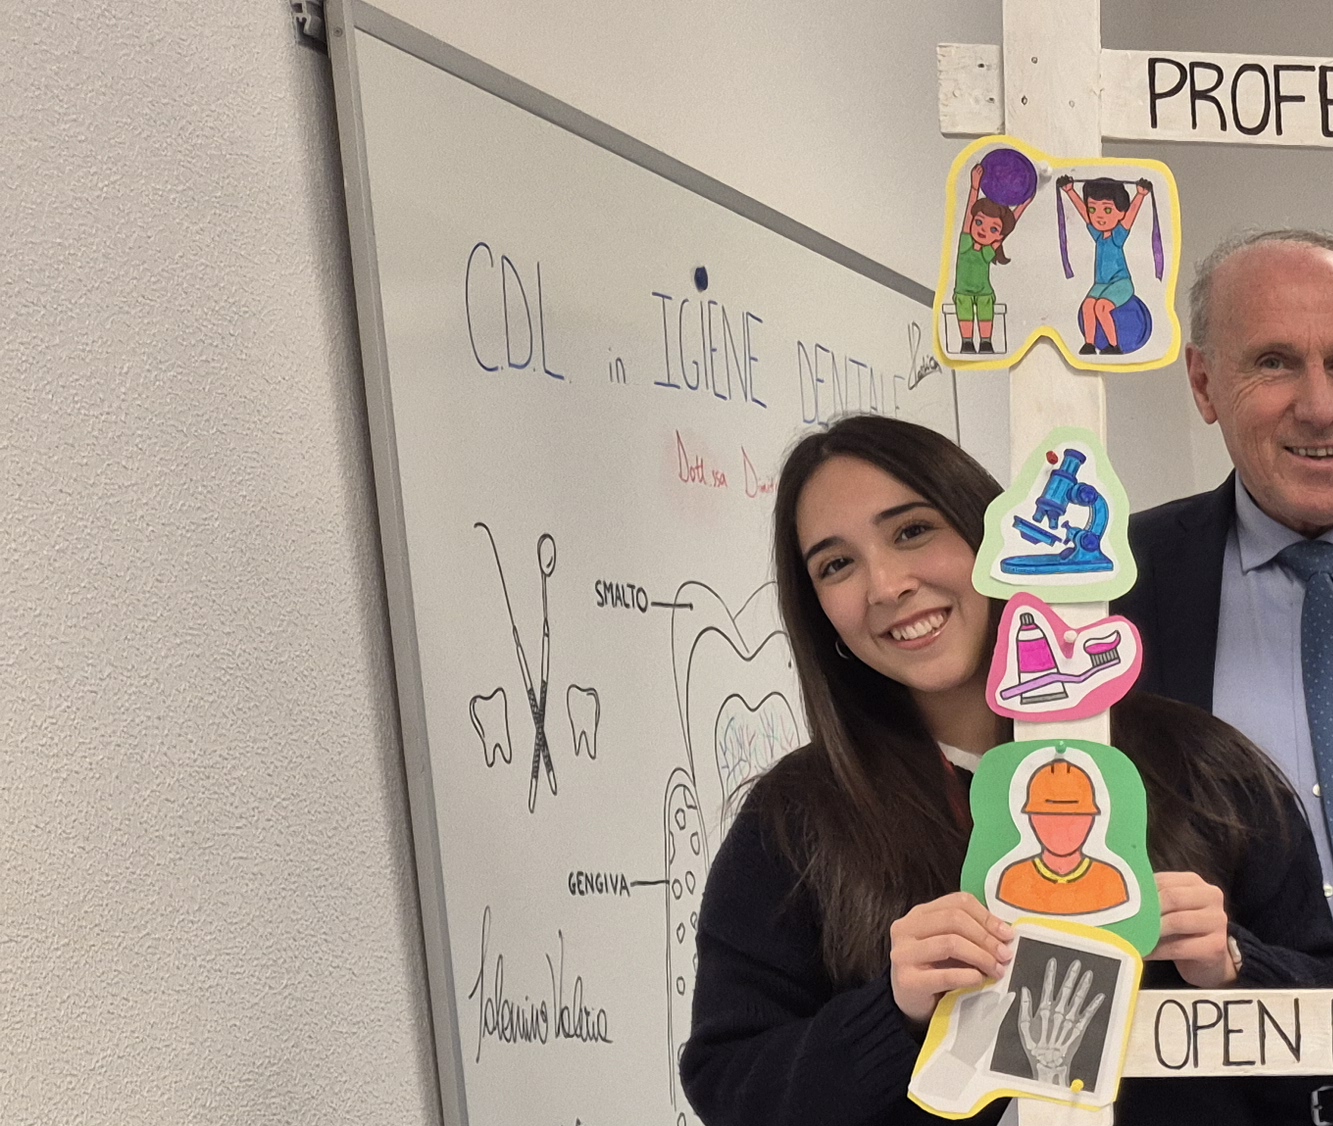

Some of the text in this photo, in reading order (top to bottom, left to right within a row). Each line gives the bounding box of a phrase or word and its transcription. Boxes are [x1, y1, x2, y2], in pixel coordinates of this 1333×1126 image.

[607, 346, 627, 385] in
[651, 291, 767, 408] IGIENE
[594, 579, 649, 613] SMALTO
[567, 871, 631, 897] GENGIVA
[1154, 997, 1301, 1070] OPEN
